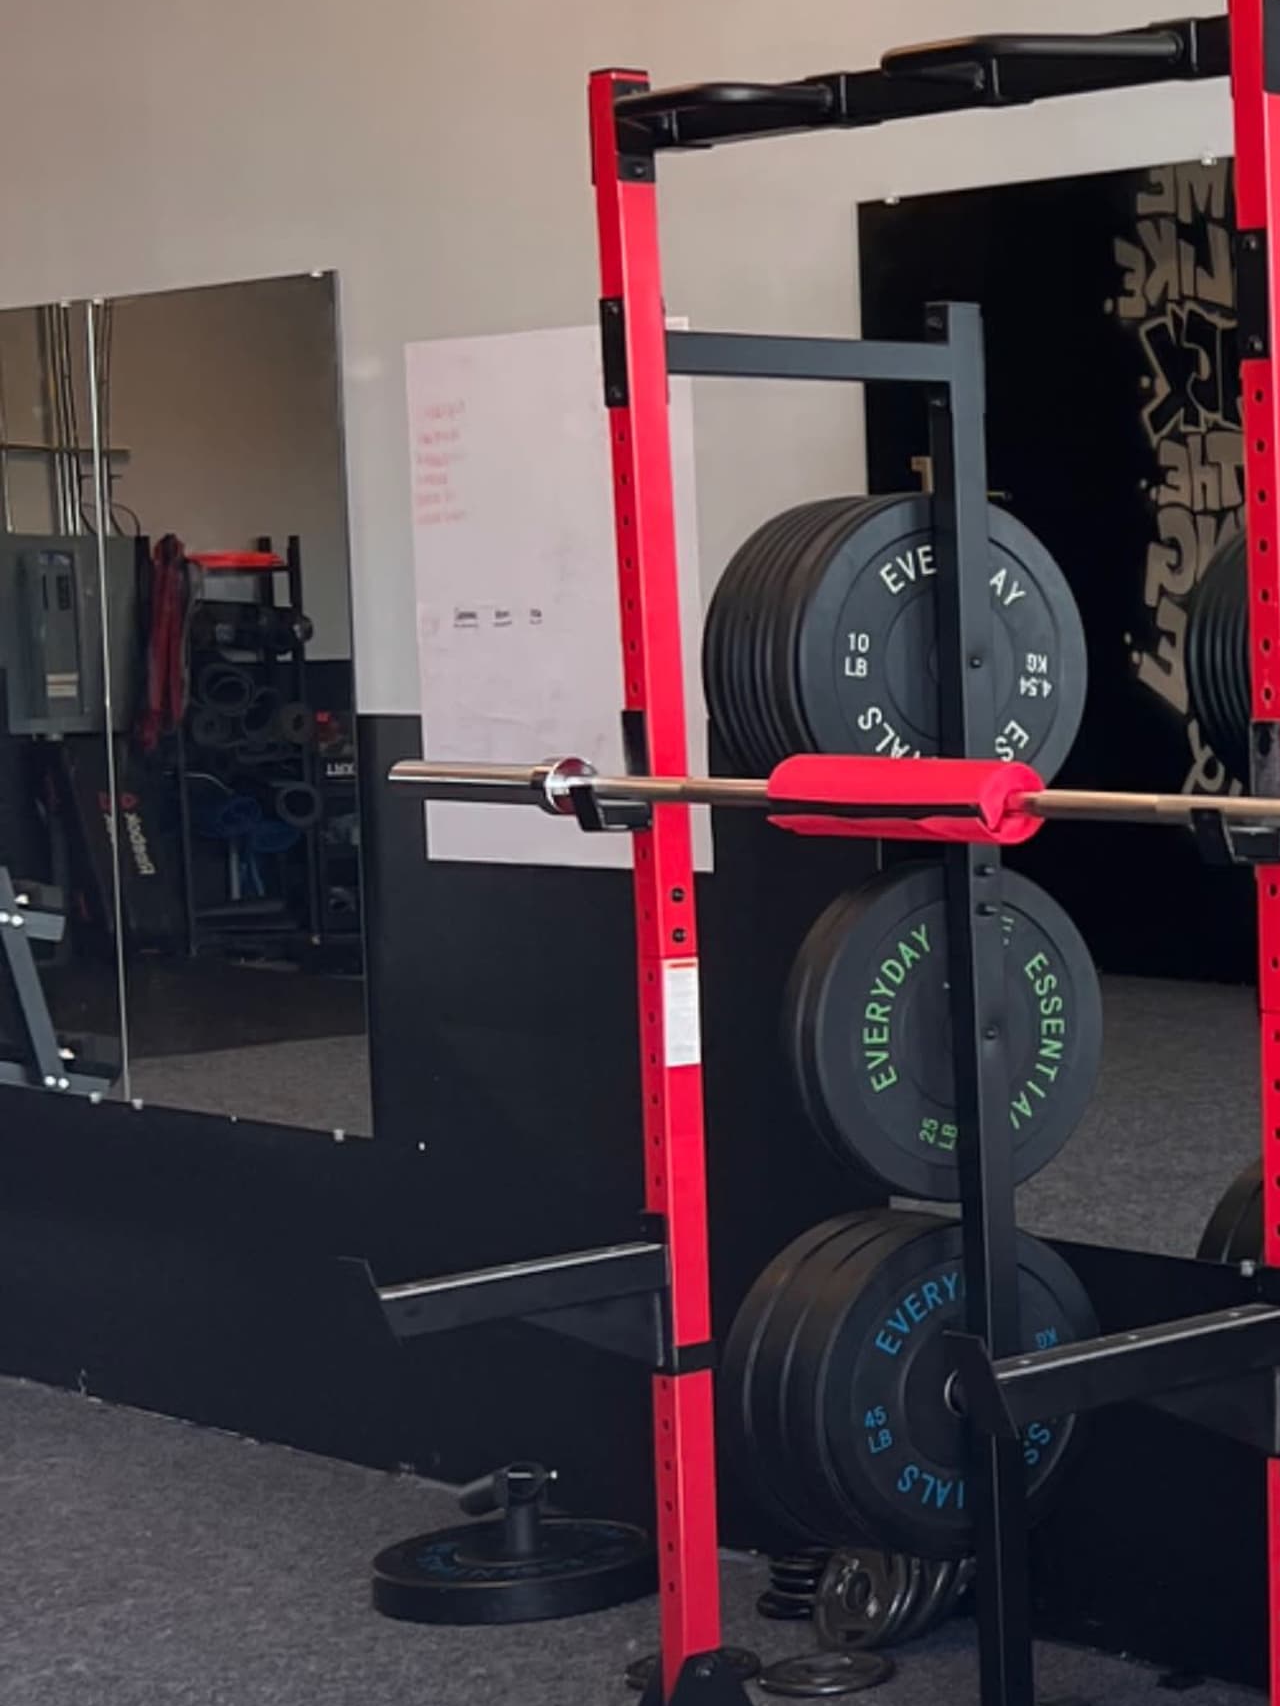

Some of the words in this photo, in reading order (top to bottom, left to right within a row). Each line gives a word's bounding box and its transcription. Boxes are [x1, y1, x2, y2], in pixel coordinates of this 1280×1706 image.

[879, 545, 1026, 607] EVEAY
[848, 632, 870, 653] 10
[844, 657, 868, 678] LB
[1025, 654, 1049, 673] KG
[861, 923, 933, 1095] EVERYDAY
[918, 1117, 940, 1144] 25
[939, 1123, 959, 1151] LB
[875, 1271, 966, 1358] EVERY
[864, 1406, 887, 1430] 45
[867, 1429, 893, 1455] LB
